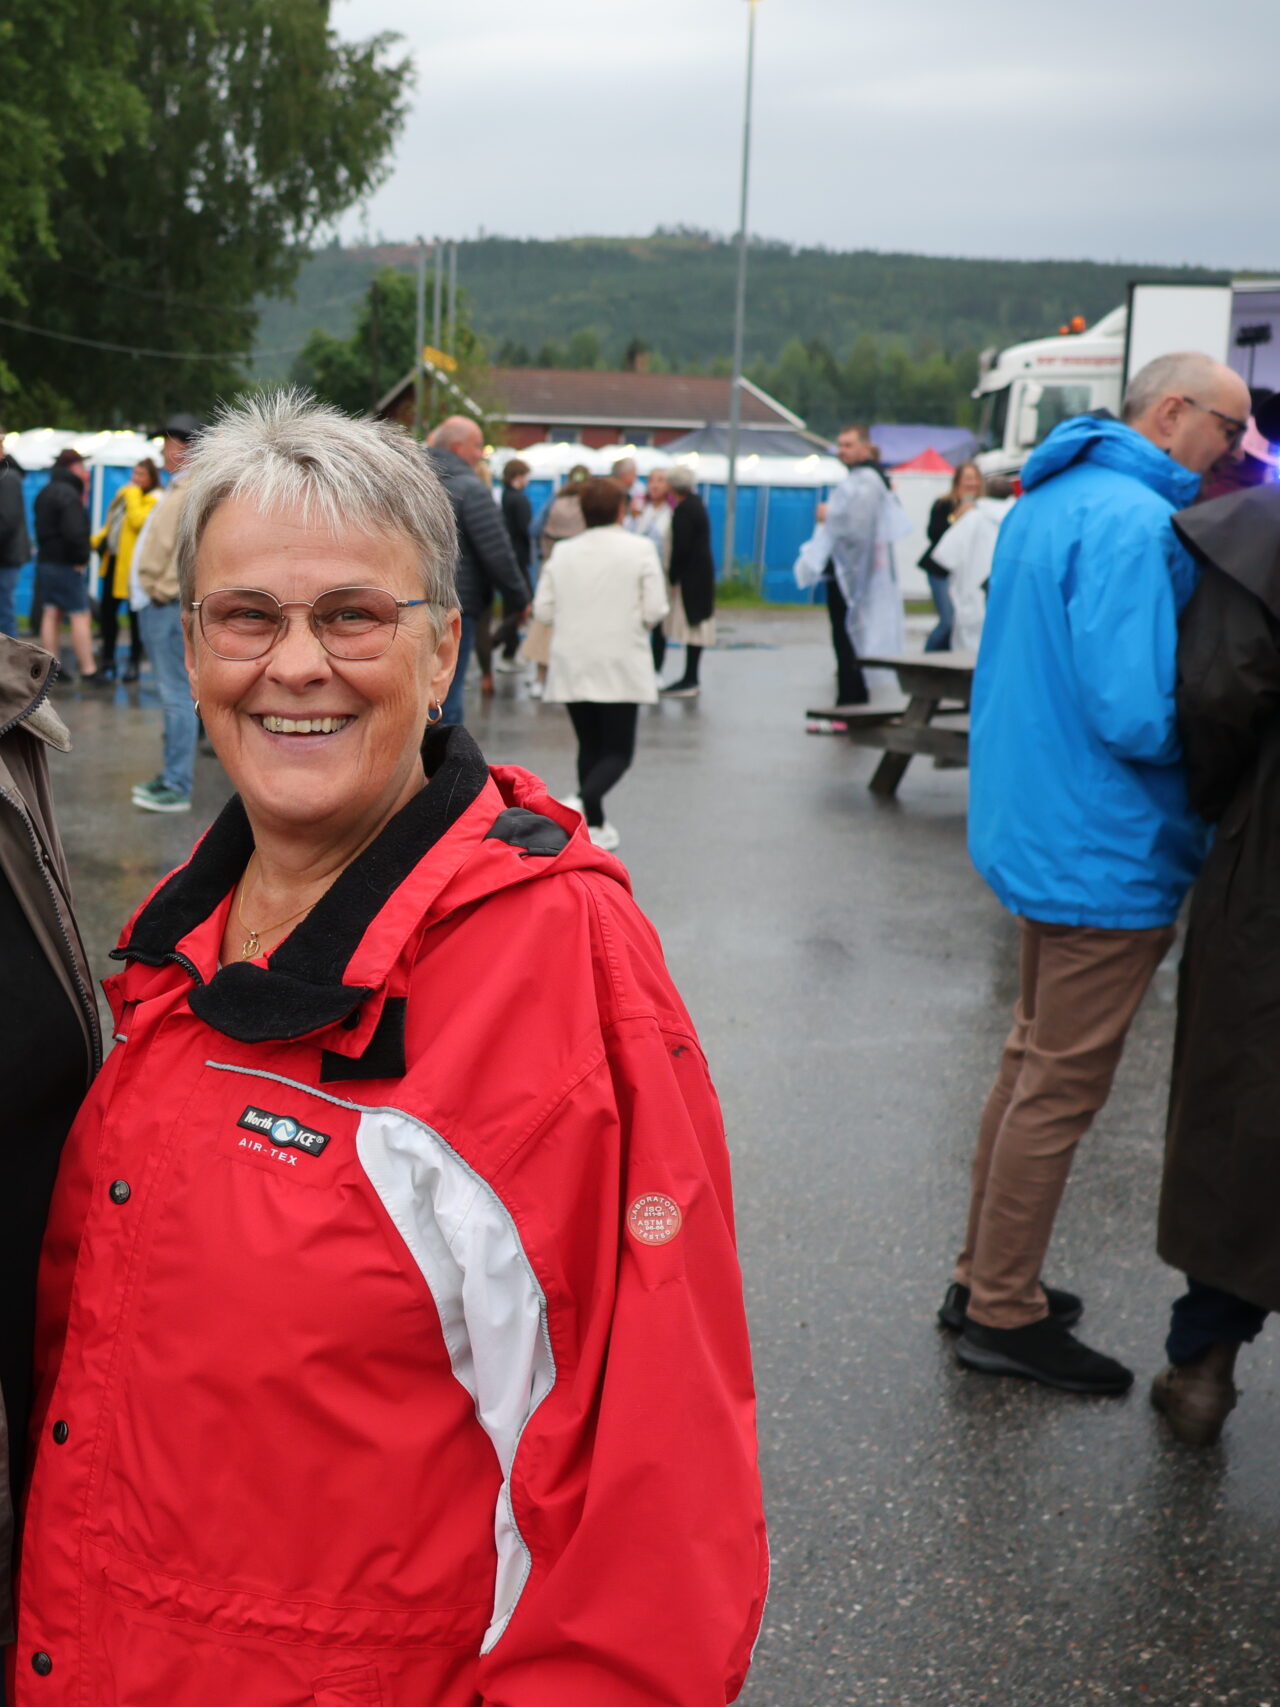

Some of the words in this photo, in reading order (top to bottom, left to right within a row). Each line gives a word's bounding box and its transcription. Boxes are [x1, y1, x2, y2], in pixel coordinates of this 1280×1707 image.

[244, 1110, 273, 1130] North
[238, 1138, 298, 1166] AIR-TEX
[631, 1196, 677, 1220] LABORATORY
[639, 1230, 671, 1240] TESTED
